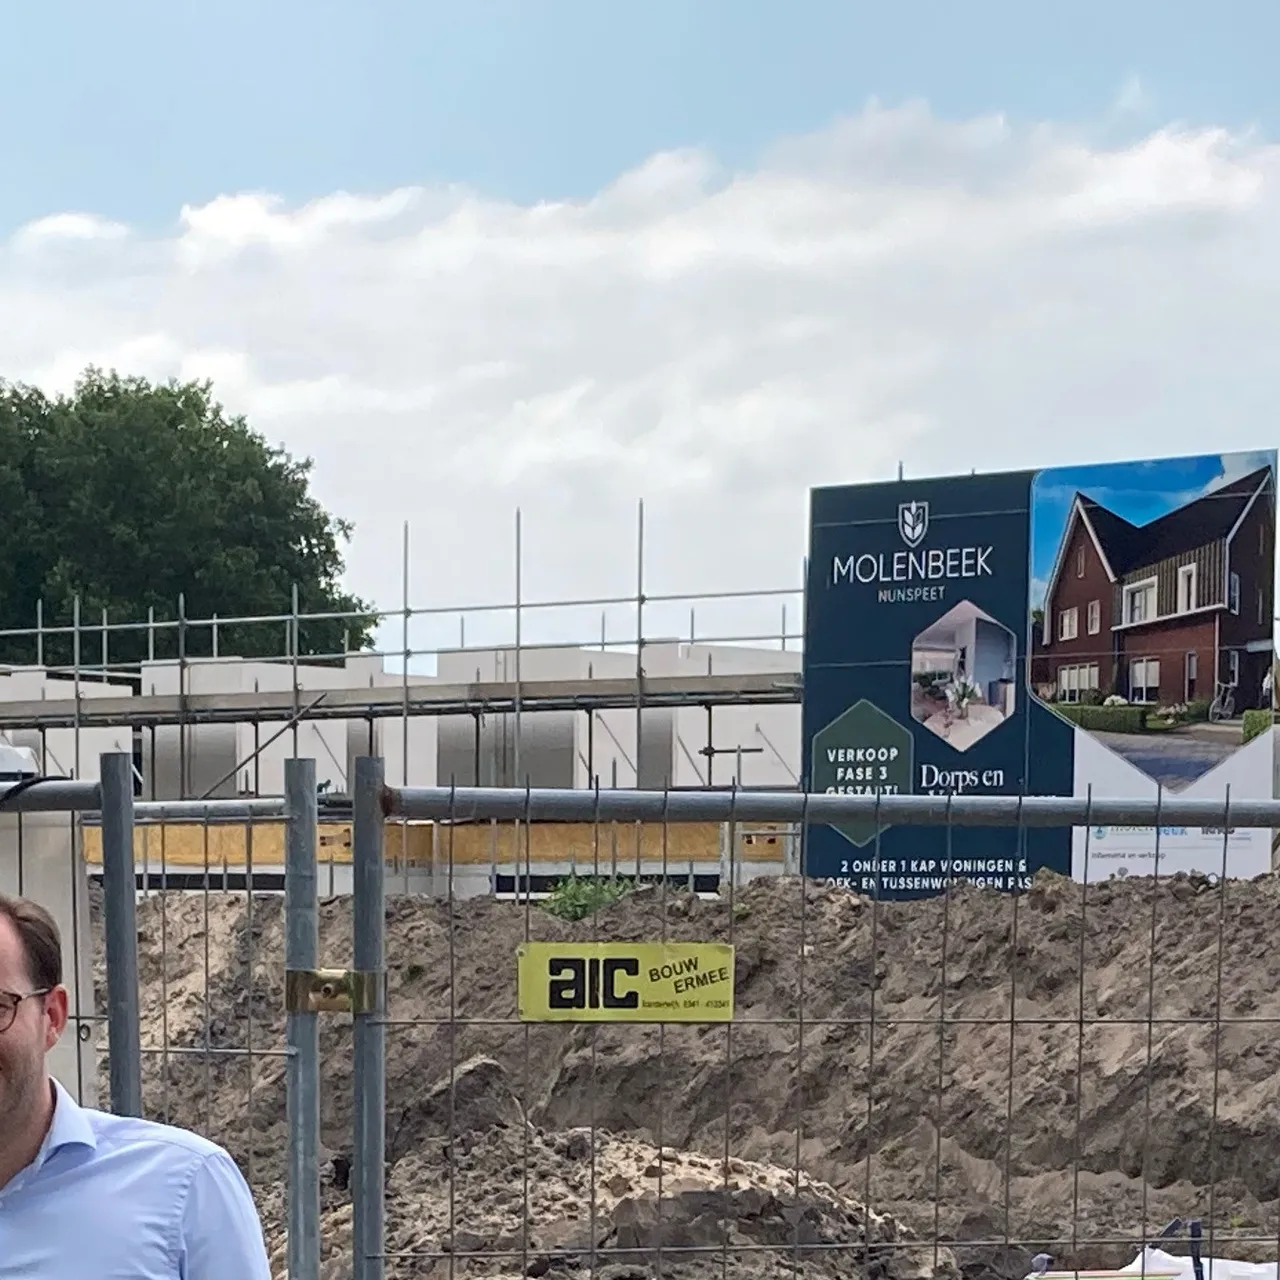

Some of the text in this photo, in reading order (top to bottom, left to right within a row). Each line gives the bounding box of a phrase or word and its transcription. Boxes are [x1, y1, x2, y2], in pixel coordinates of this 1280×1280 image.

[833, 546, 994, 585] MOLENBEEK
[877, 585, 946, 603] NUNSPEET
[827, 747, 899, 763] VERKOOP
[836, 766, 888, 781] FASE 3
[920, 763, 1005, 793] Dorps en
[840, 860, 849, 872] 2
[852, 860, 897, 872] ONDER
[900, 860, 907, 872] 1
[910, 860, 937, 872] KAP
[649, 957, 699, 983] BOUW
[674, 967, 730, 995] ERMEE
